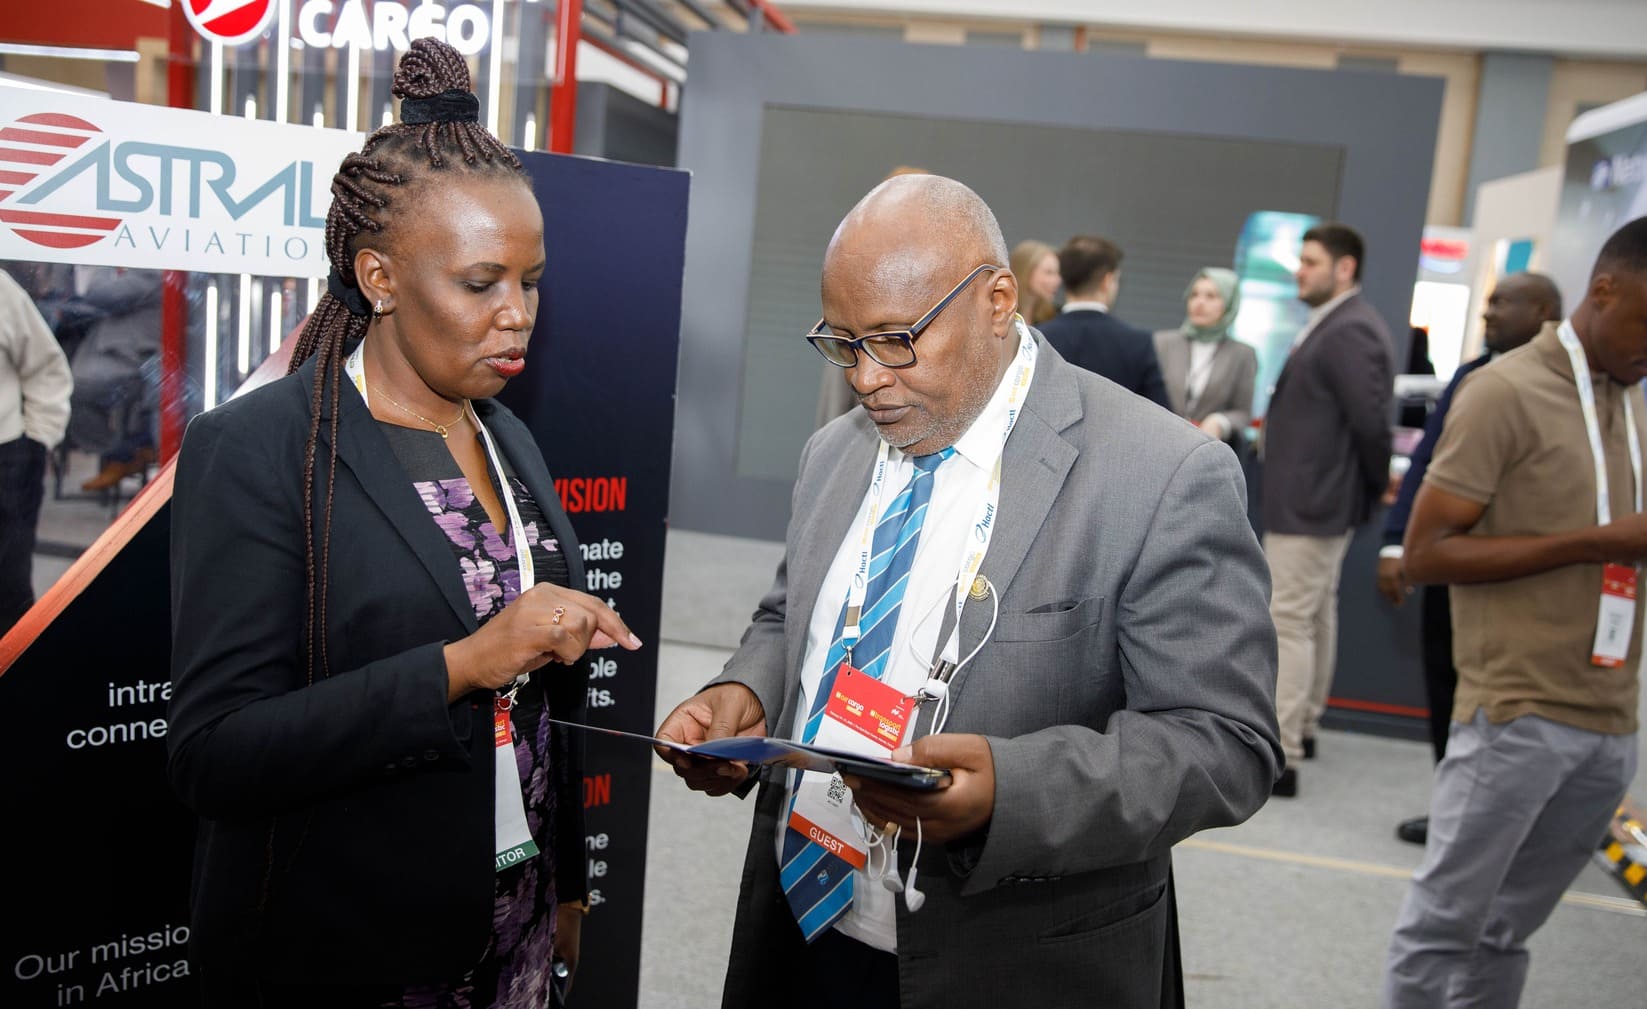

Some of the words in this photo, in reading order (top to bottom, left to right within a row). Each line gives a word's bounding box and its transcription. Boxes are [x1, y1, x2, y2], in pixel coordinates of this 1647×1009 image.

[299, 0, 490, 55] CARGO
[16, 140, 326, 229] ASTRAL
[114, 224, 326, 262] AVIATIO
[586, 568, 623, 590] the
[496, 847, 526, 868] ITOR
[809, 827, 845, 854] GUEST
[15, 950, 80, 980] Our
[57, 983, 85, 1008] in
[96, 959, 190, 998] Africa
